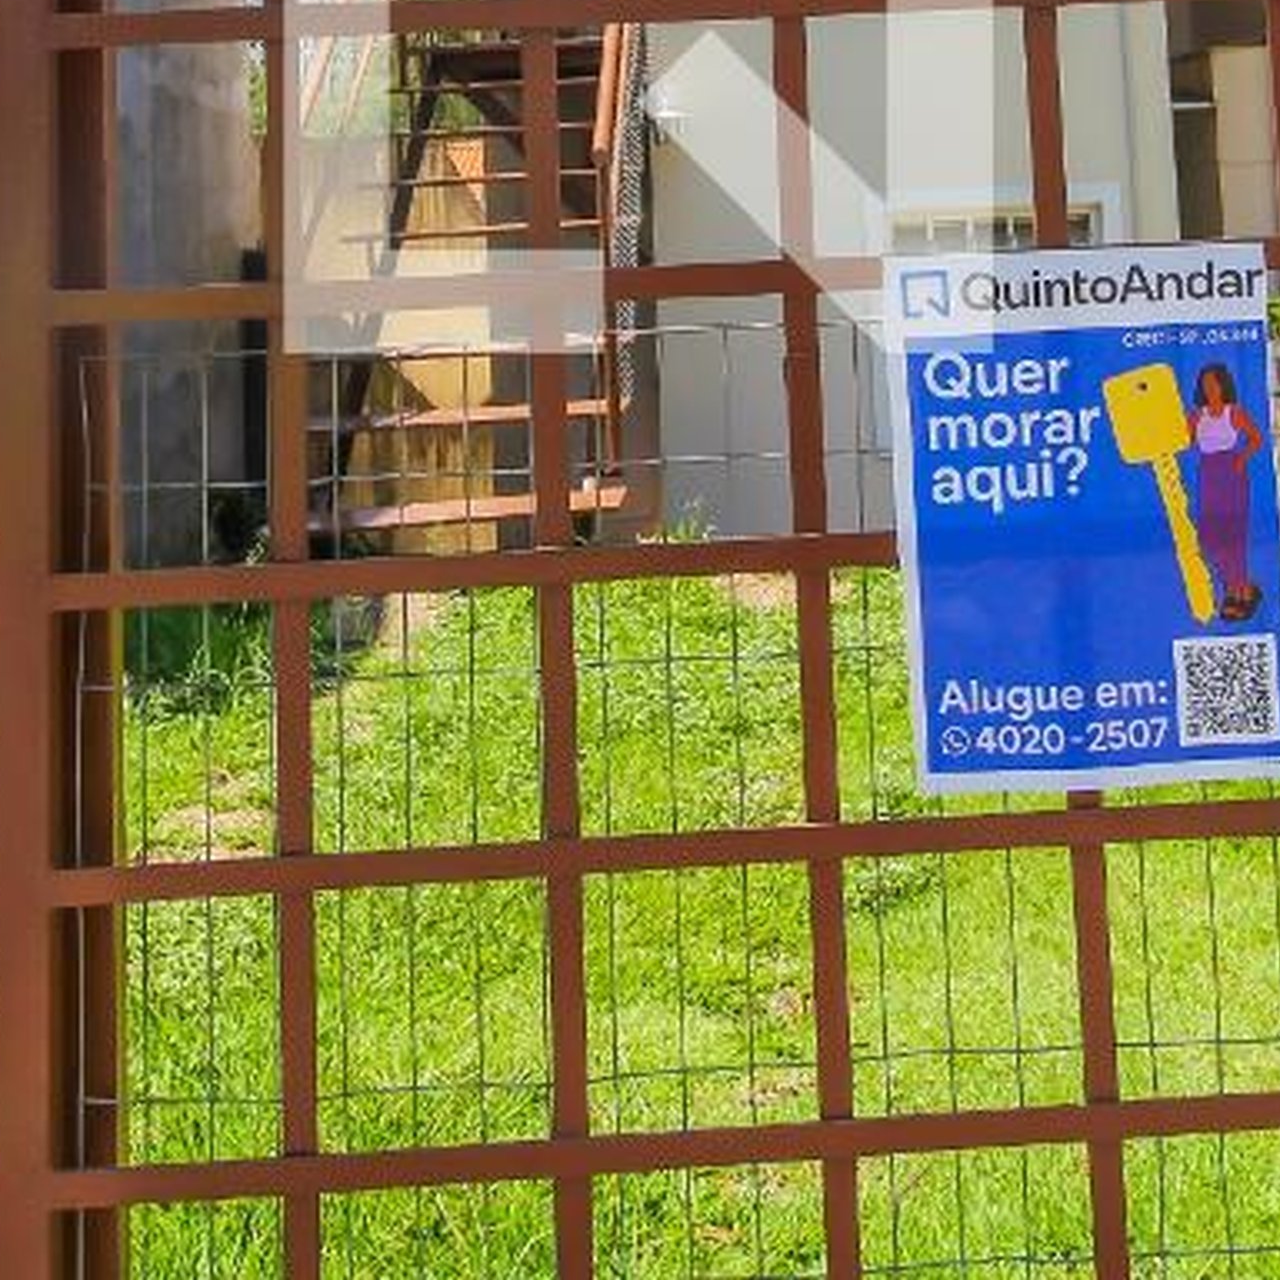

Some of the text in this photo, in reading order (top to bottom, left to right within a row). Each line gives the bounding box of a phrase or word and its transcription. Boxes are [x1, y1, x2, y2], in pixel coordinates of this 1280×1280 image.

[962, 261, 1264, 313] QuintoAndar
[923, 351, 1069, 400] Quer
[928, 403, 1100, 451] morar
[931, 448, 1089, 513] aqui?
[938, 678, 1168, 720] Alugue em:
